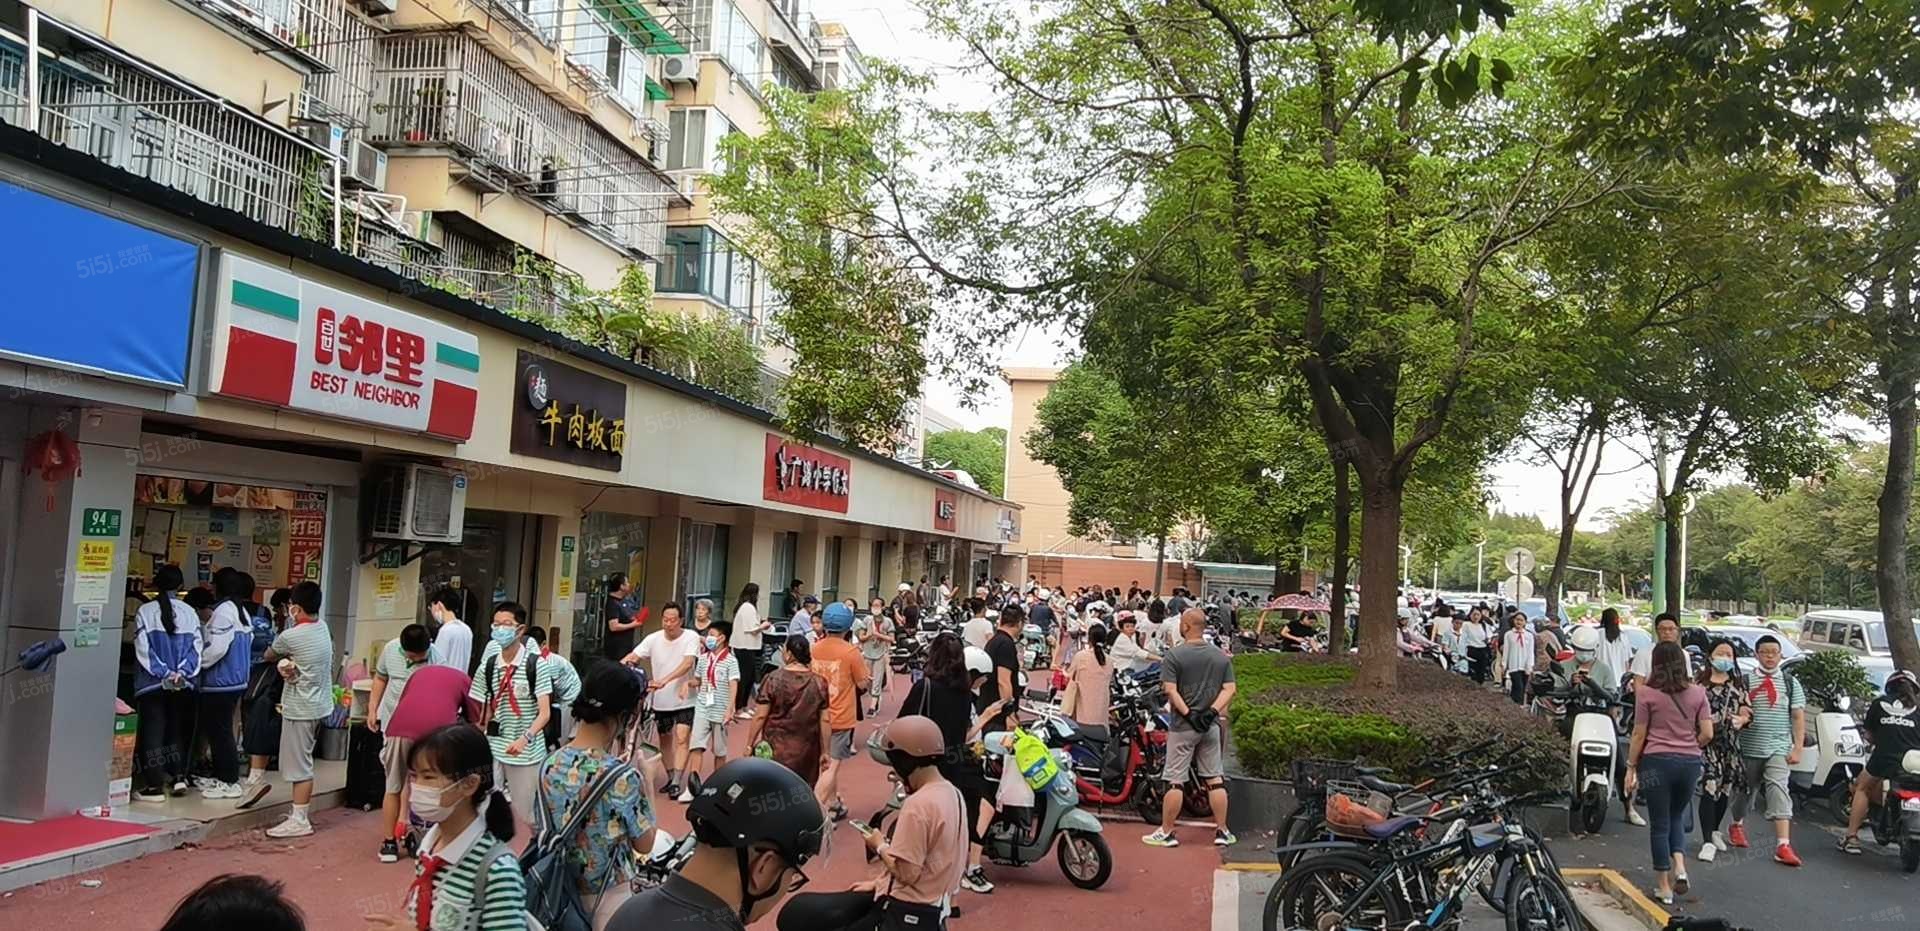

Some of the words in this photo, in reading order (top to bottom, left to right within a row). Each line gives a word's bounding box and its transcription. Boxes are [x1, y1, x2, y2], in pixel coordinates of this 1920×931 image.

[338, 314, 425, 388] 邻里
[310, 371, 348, 394] BEST
[353, 380, 421, 410] NEIGHBOR
[540, 399, 627, 457] 牛肉板面
[92, 510, 107, 526] 94
[290, 518, 322, 536] 打印
[1880, 716, 1915, 727] adidas
